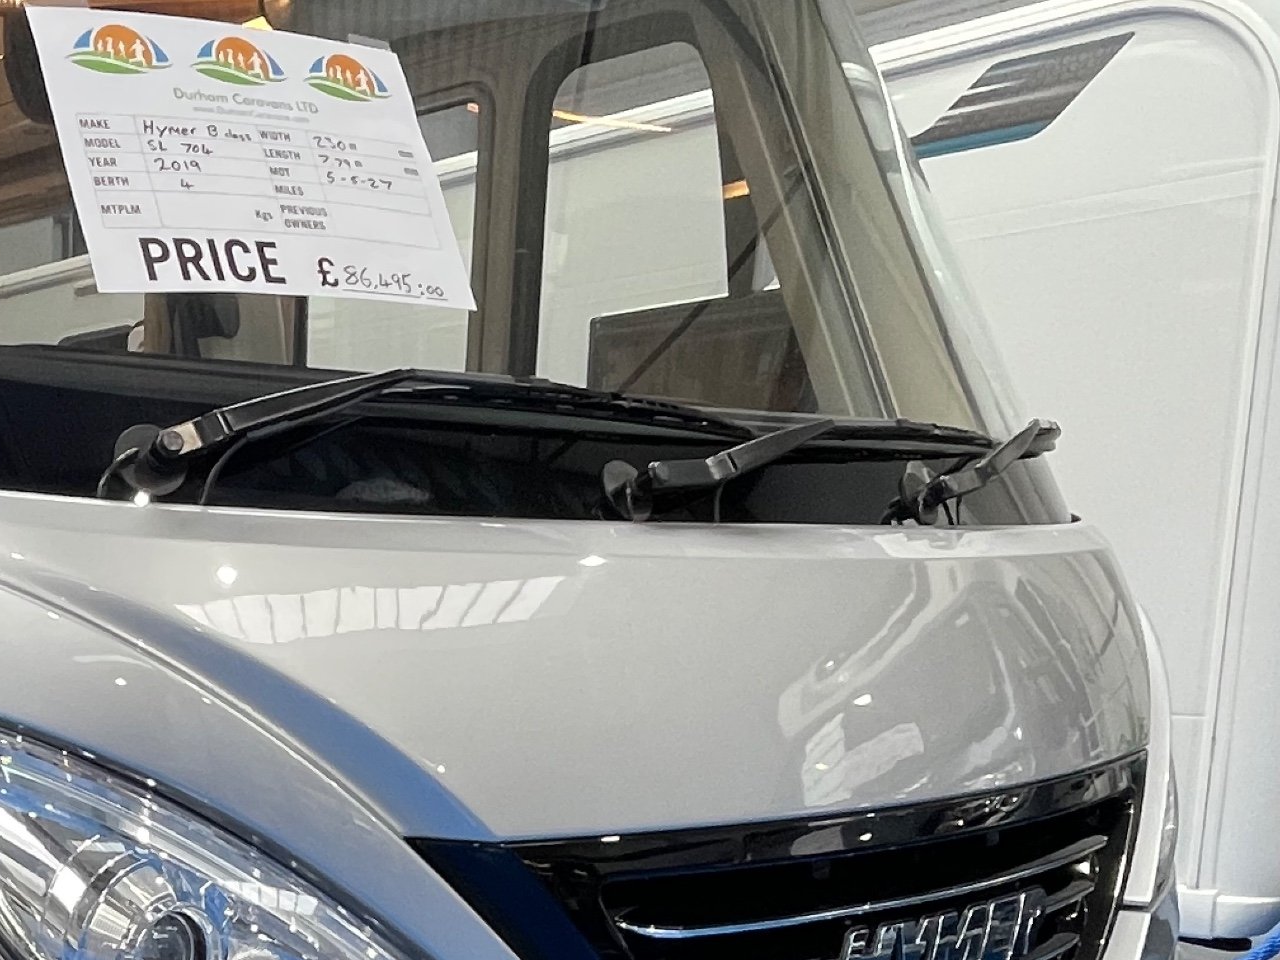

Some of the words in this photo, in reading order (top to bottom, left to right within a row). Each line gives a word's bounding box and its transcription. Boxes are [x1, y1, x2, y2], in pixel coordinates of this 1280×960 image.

[173, 87, 229, 103] Durham
[232, 93, 294, 112] Caravans
[295, 100, 319, 114] LTD
[79, 118, 111, 130] MAKE
[206, 124, 219, 137] B
[258, 130, 291, 142] WIDTH
[84, 138, 122, 149] MODEL
[147, 139, 168, 151] SL
[180, 142, 214, 156] 704
[263, 148, 301, 160] LENGTH
[88, 157, 118, 168] YEAR
[153, 157, 201, 173] 2019
[269, 166, 290, 177] MOT
[93, 176, 130, 187] BERTH
[180, 178, 195, 191] 4
[274, 184, 304, 196] MILES
[100, 204, 142, 215] MTPLM
[279, 204, 328, 218] PREVIOUS
[284, 218, 326, 231] OWNERS
[137, 236, 287, 285] PRICE
